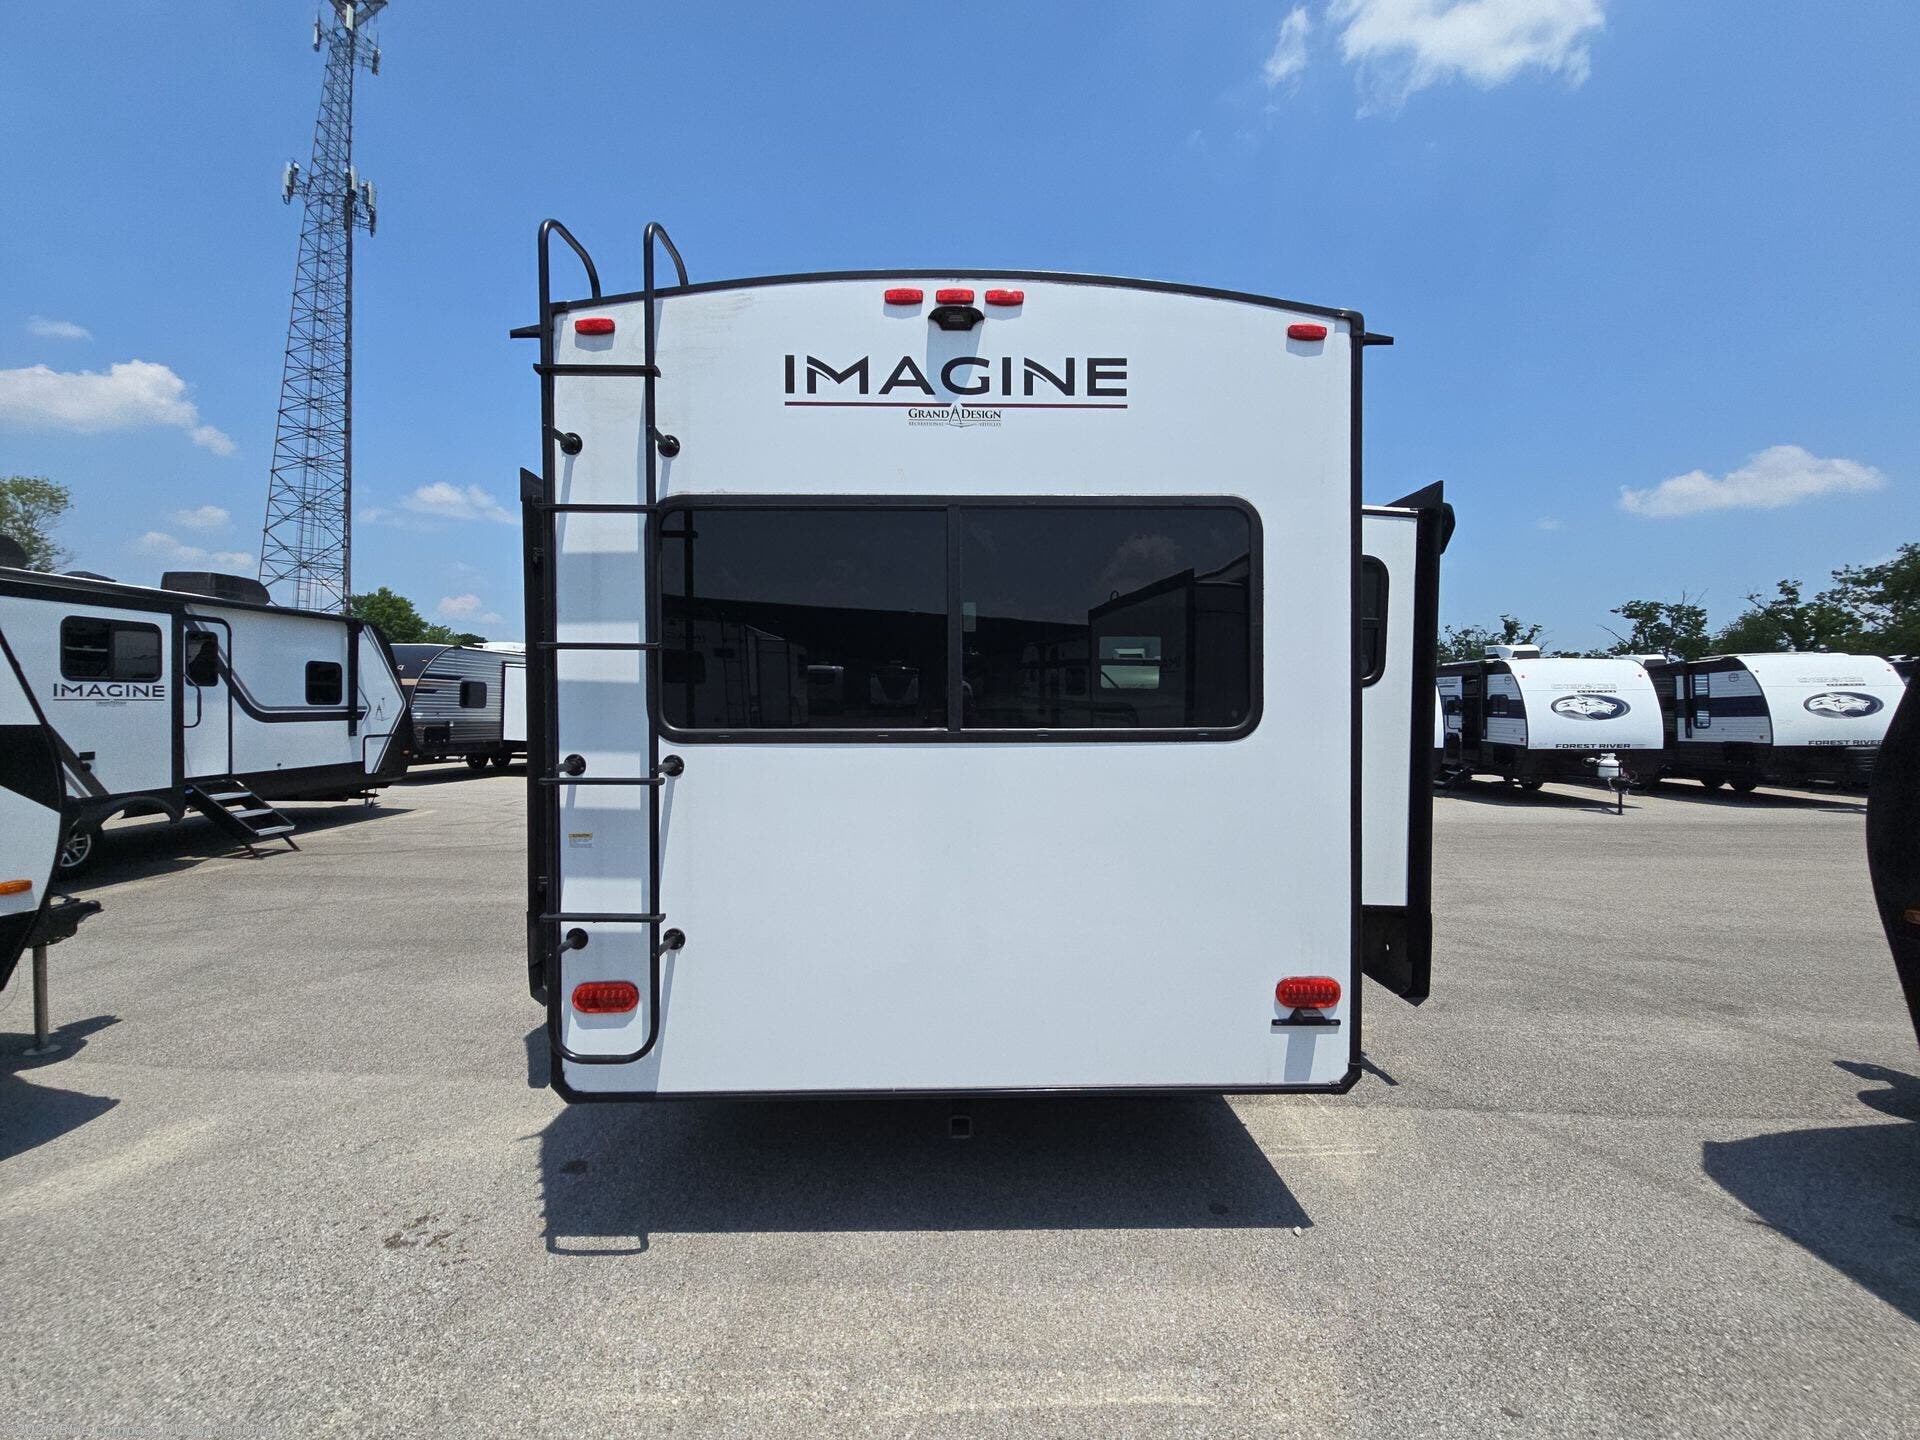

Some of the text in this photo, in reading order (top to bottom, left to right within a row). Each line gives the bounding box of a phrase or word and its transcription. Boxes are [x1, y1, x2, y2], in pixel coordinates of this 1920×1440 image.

[784, 355, 1128, 397] IMAGINE
[908, 408, 1001, 419] GRAND DESIGN
[53, 683, 165, 698] IMAGINE
